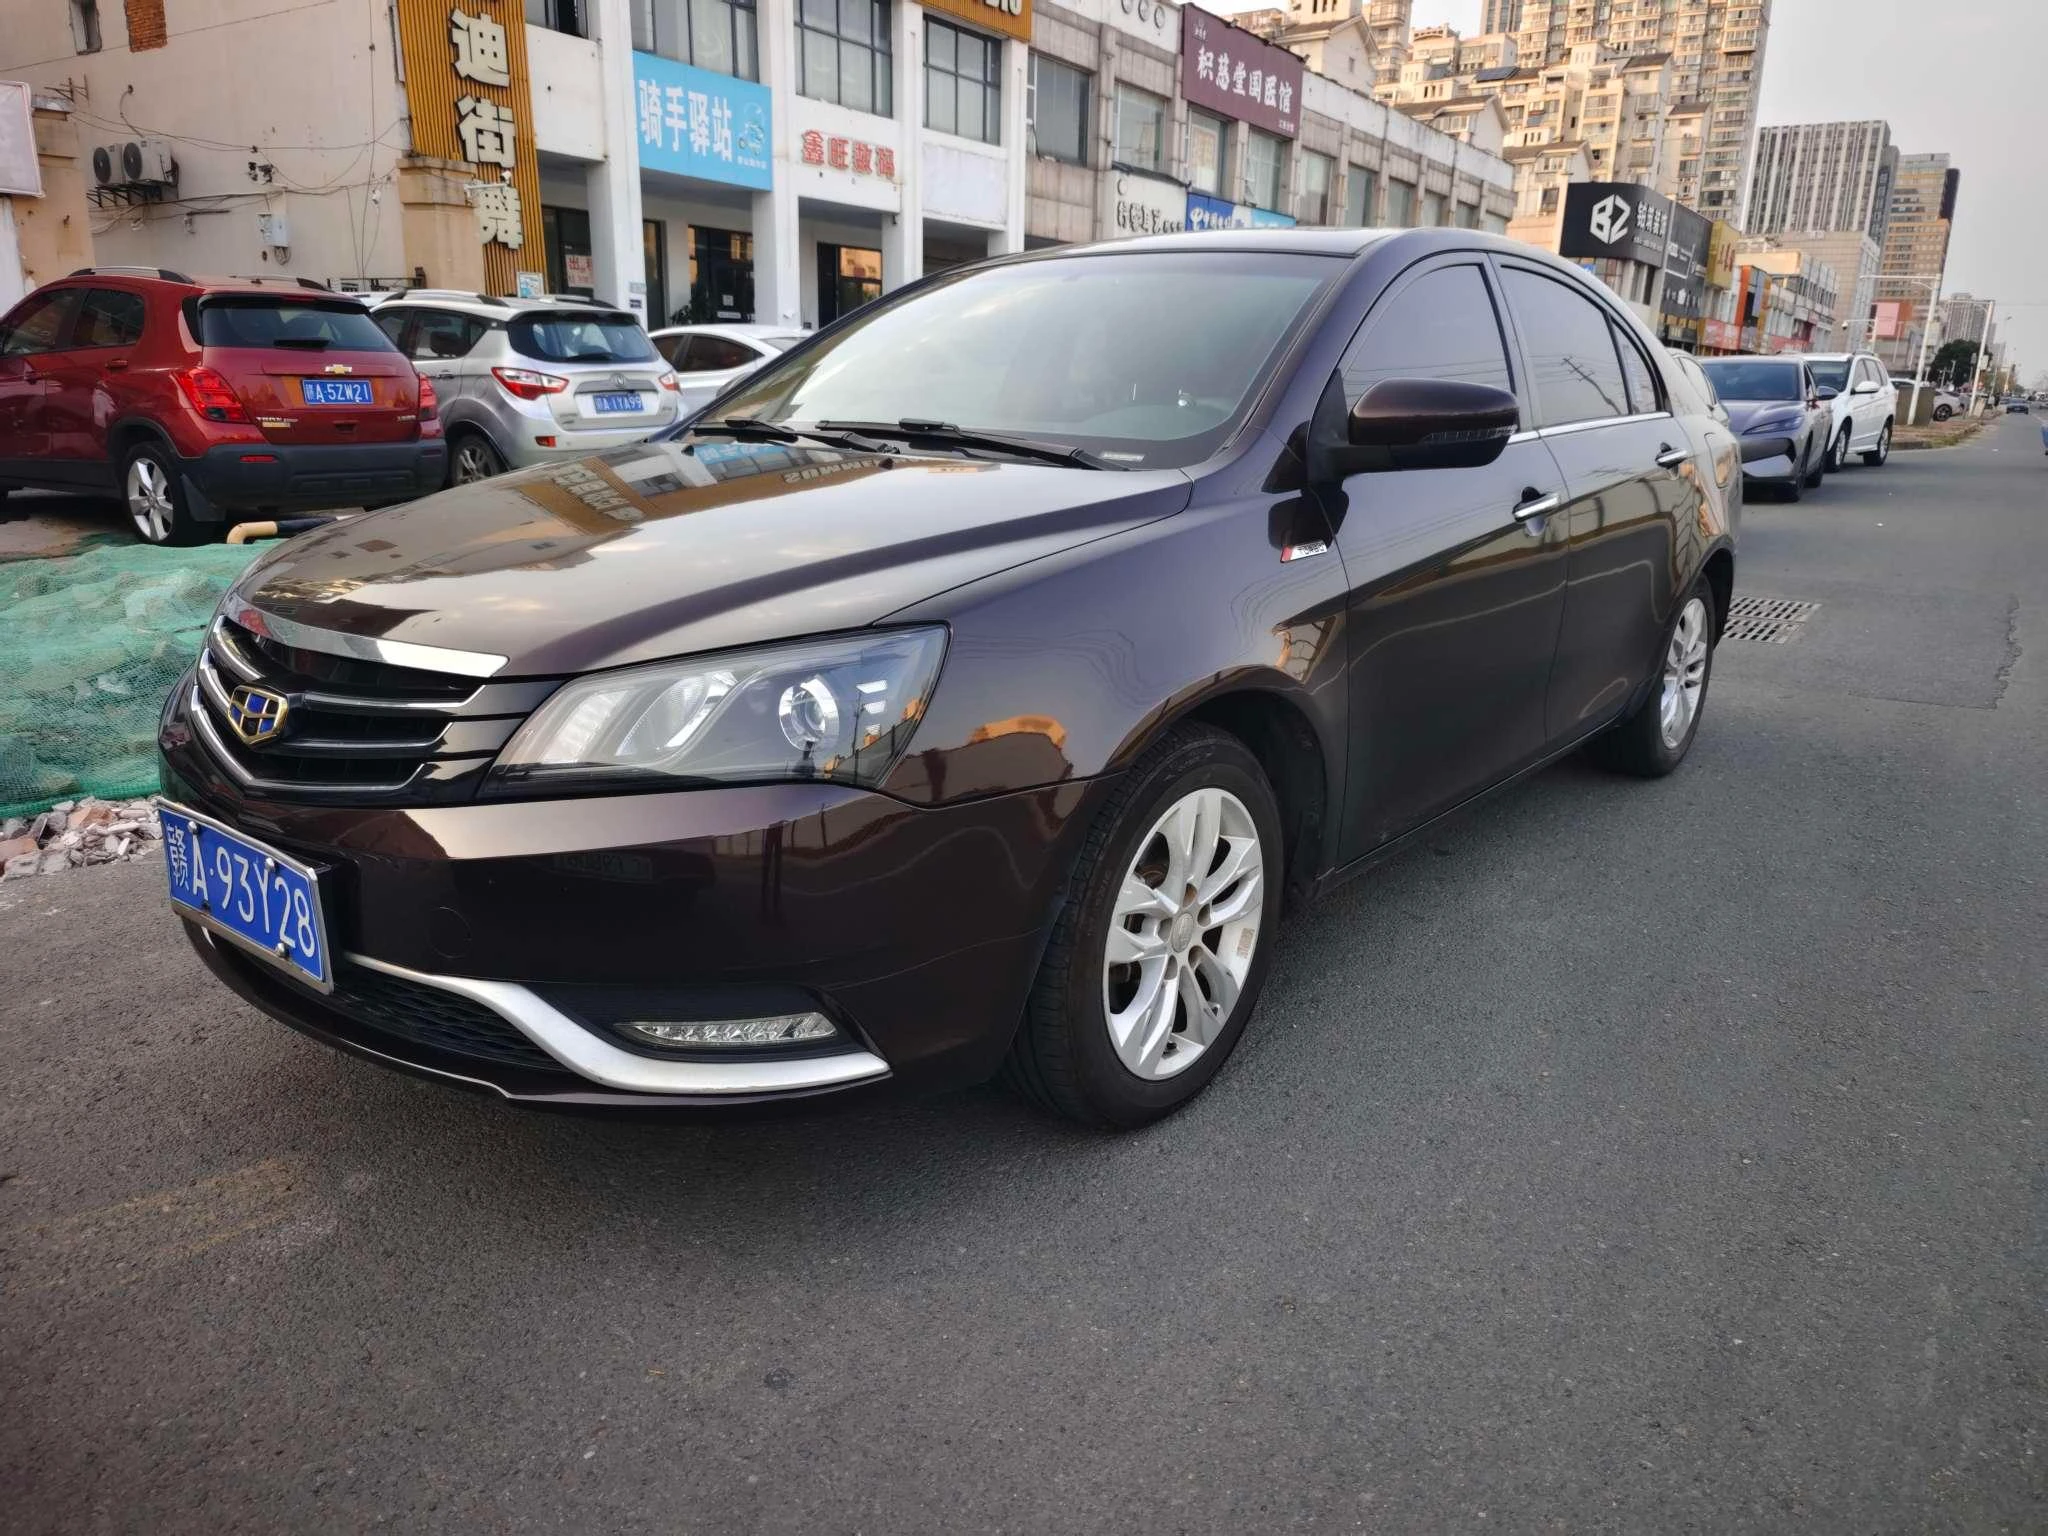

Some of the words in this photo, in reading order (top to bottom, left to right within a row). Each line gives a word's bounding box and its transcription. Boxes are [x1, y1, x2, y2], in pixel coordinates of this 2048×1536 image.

[639, 79, 733, 162] 骑手驿站
[801, 129, 895, 178] 鑫旺数码
[166, 823, 315, 958] 赣A·93Y28
